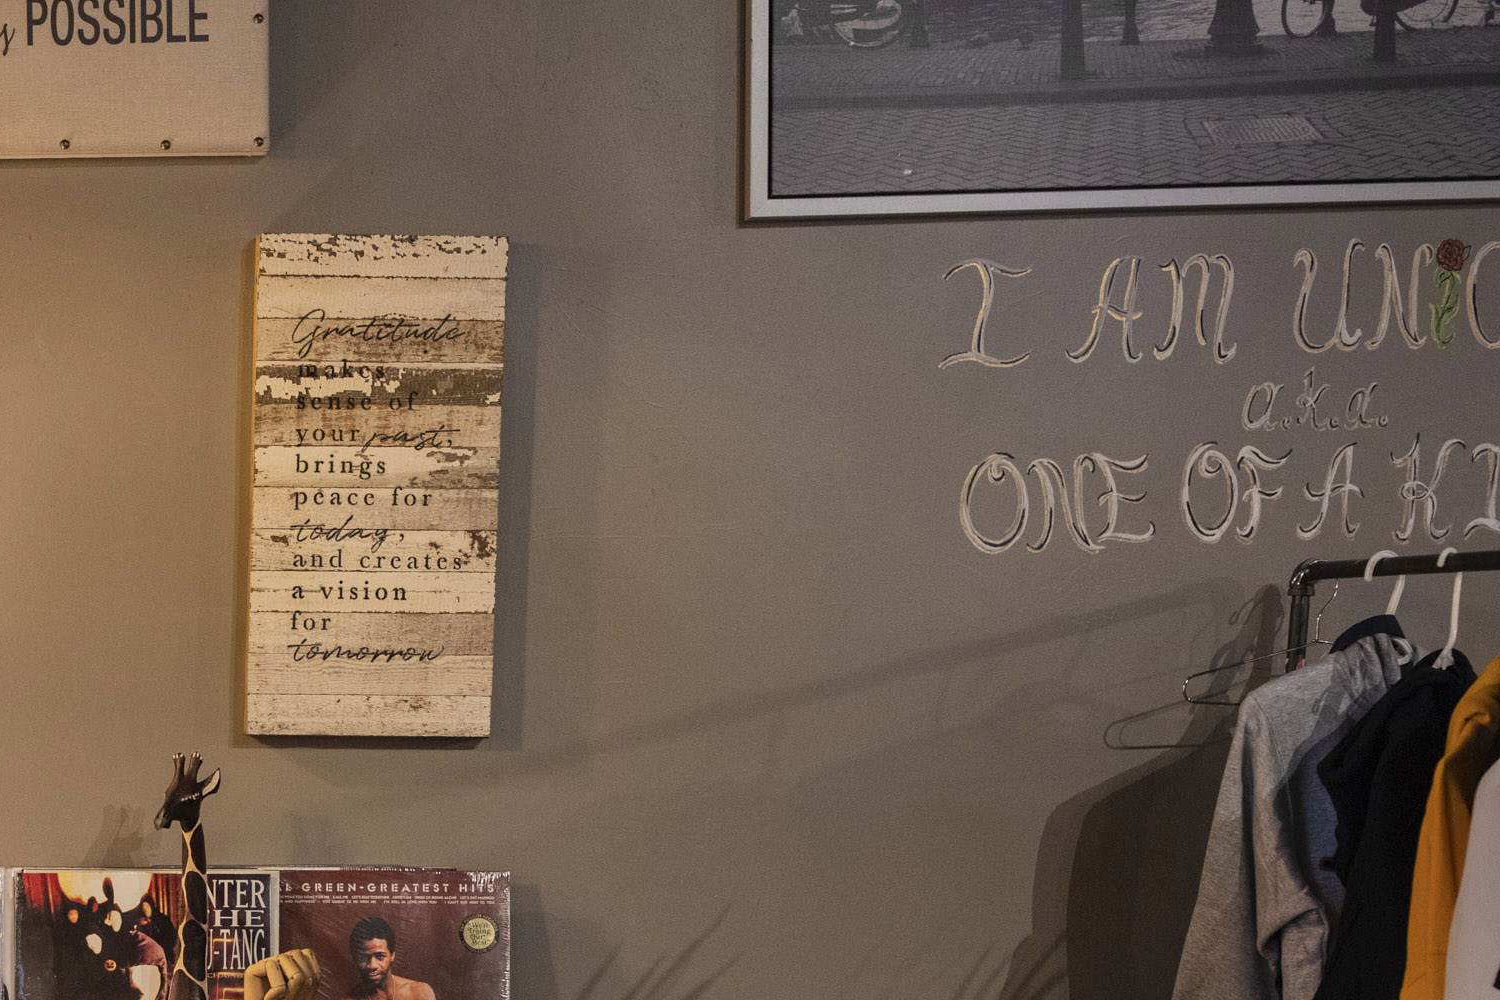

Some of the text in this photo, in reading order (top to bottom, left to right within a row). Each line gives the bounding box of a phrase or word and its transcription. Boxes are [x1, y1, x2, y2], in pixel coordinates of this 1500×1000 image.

[26, 0, 210, 46] POSSIBLE
[937, 257, 1032, 369] I
[1065, 254, 1238, 364] AM
[291, 309, 466, 357] Gratitude
[297, 360, 386, 380] makes
[296, 391, 419, 411] sense of
[295, 427, 360, 447] your
[295, 454, 387, 480] brings
[292, 486, 434, 511] peace for
[959, 452, 1156, 554] ONE
[1180, 441, 1293, 544] OF
[1296, 443, 1364, 541] A
[292, 551, 463, 571] and creates
[291, 580, 408, 602] a vision
[290, 613, 332, 631] for
[287, 637, 445, 663] tomorrow
[207, 879, 266, 909] NTER
[459, 882, 495, 893] HITS
[208, 909, 265, 927] HE
